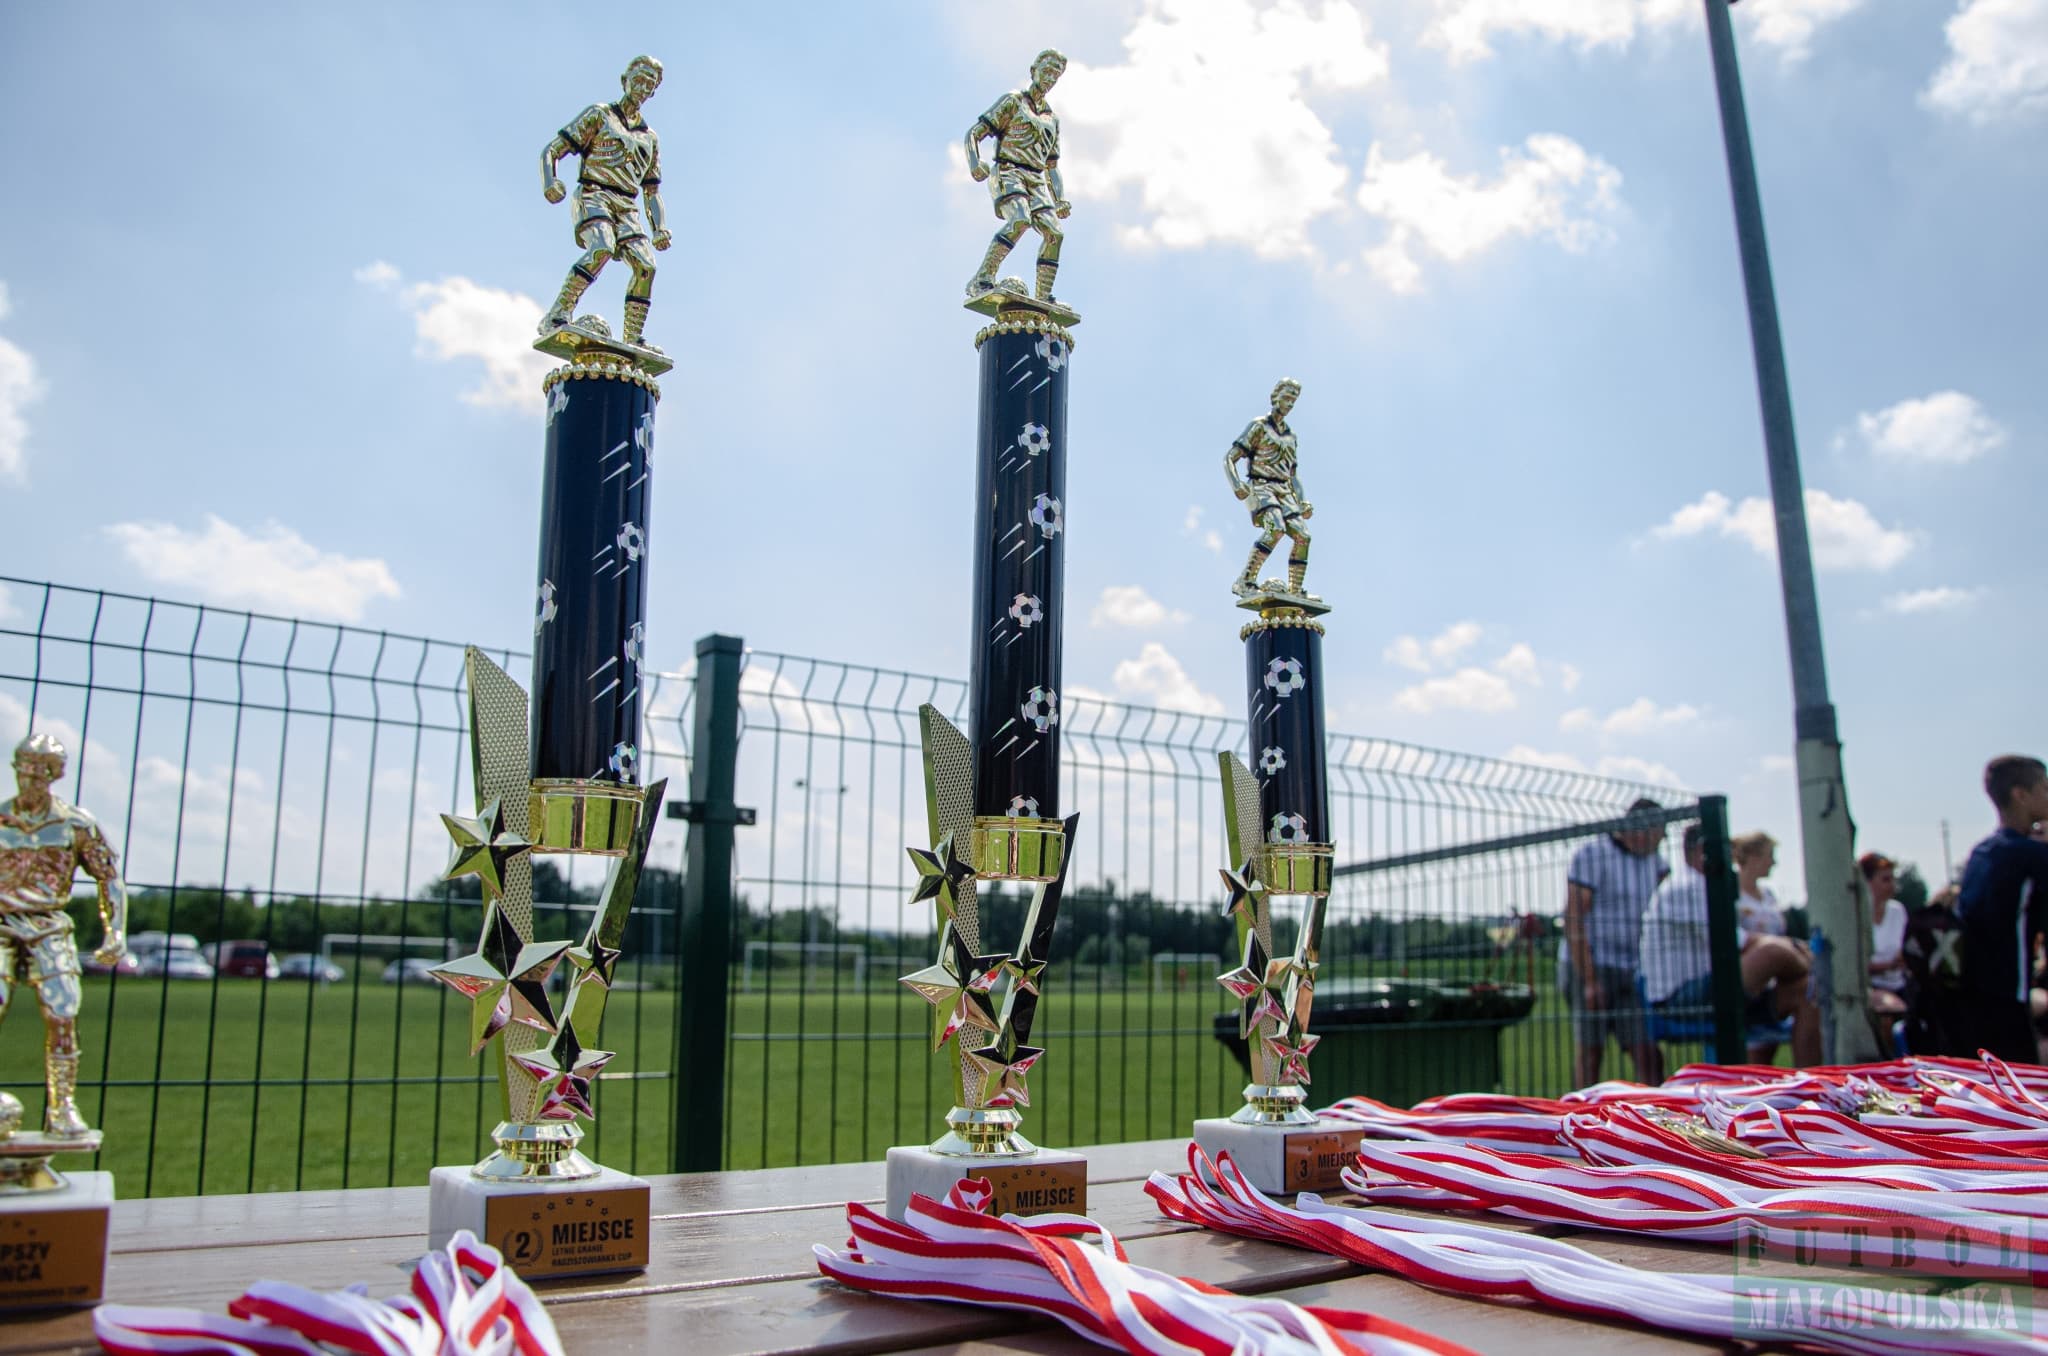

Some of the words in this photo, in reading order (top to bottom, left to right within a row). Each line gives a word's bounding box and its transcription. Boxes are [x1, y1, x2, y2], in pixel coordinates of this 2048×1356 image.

[1300, 1159, 1308, 1178] 3
[1318, 1151, 1358, 1168] MIEJSCE
[1016, 1187, 1075, 1208] MIEJSCE
[515, 1231, 531, 1259] 2
[552, 1219, 633, 1245] MIEJSCE
